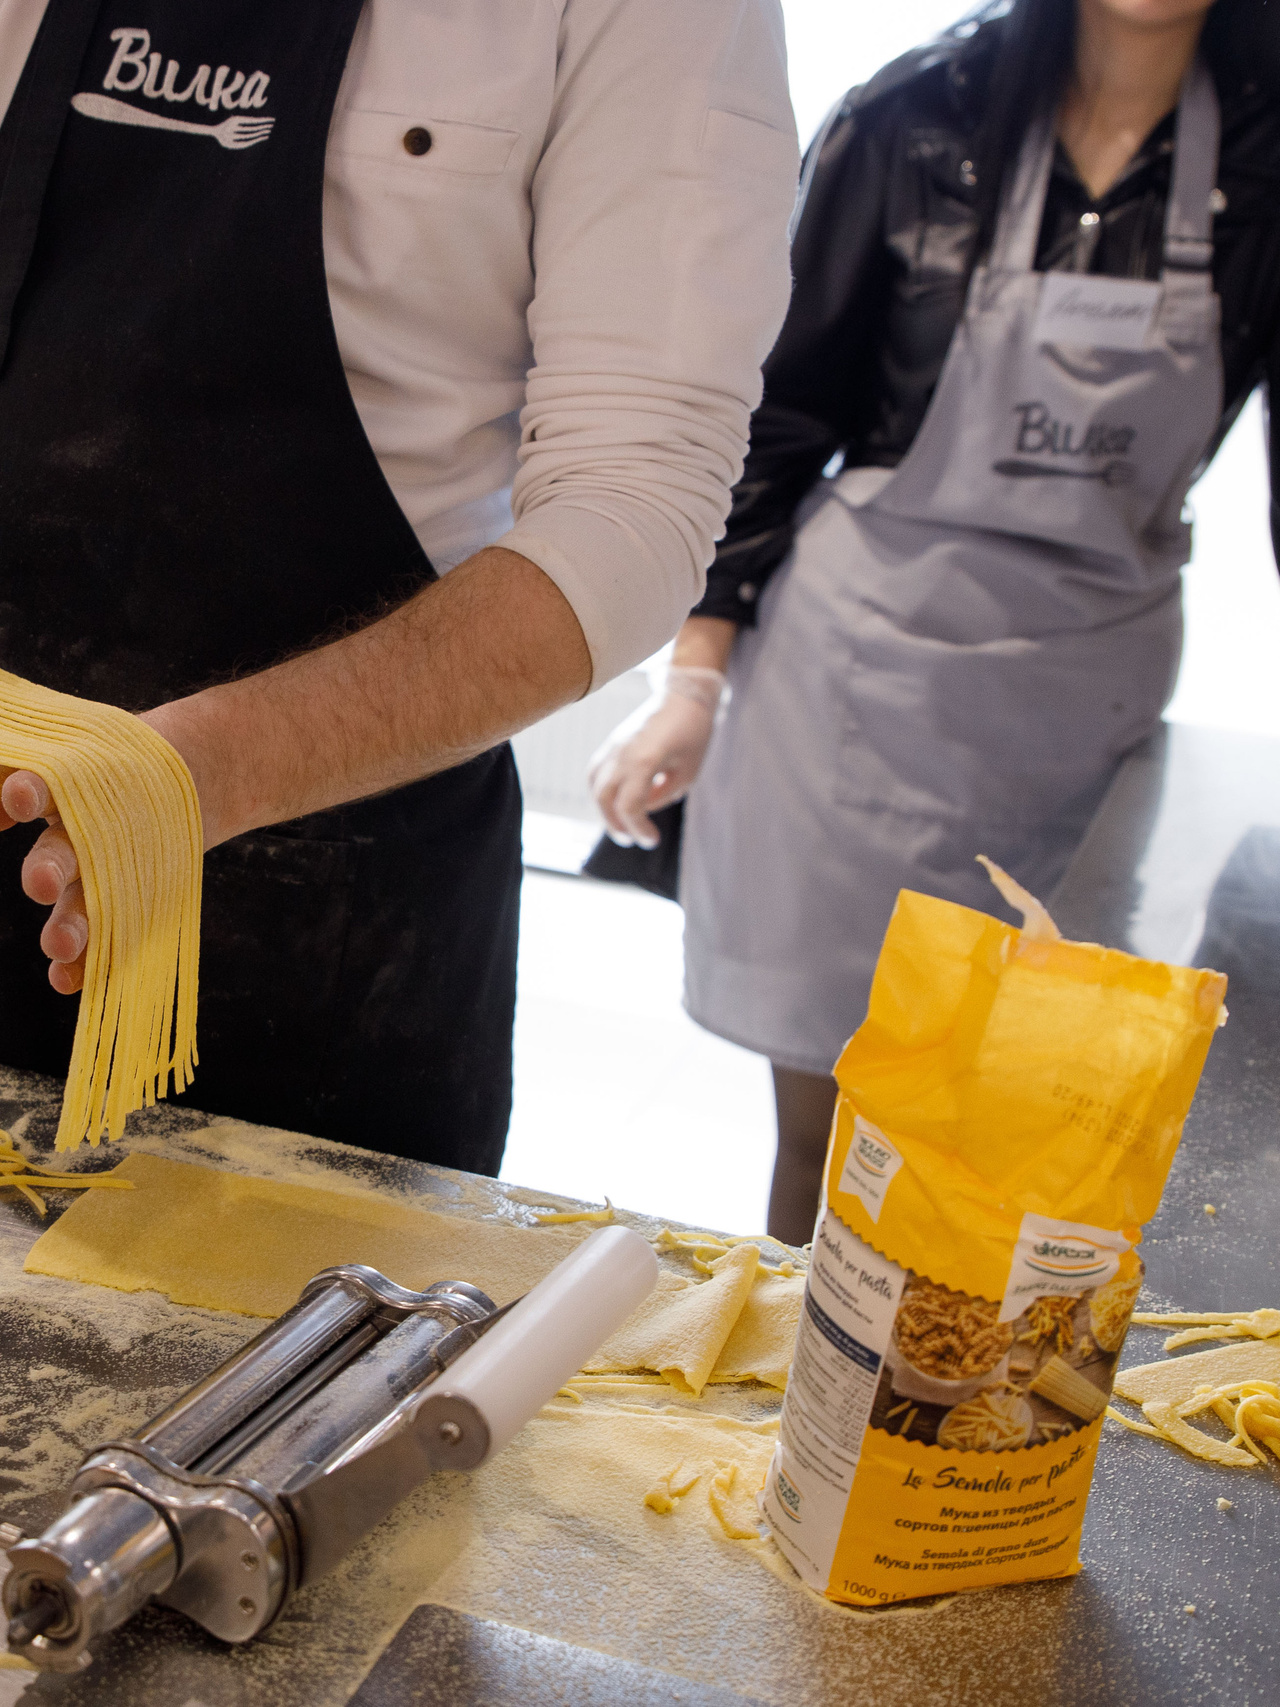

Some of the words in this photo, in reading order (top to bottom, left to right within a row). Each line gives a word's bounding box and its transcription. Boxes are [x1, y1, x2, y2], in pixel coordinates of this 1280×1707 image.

[103, 27, 271, 111] Вилка
[902, 1467, 924, 1490] La
[932, 1466, 1012, 1494] Semola
[1018, 1473, 1042, 1493] per
[940, 1506, 979, 1520] Мука
[982, 1509, 999, 1518] из
[1003, 1496, 1057, 1516] твердых
[895, 1518, 949, 1532] сортов
[1021, 1513, 1045, 1528] для
[922, 1549, 969, 1559] Semola
[972, 1546, 984, 1556] di
[986, 1543, 1021, 1556] grano
[1023, 1536, 1049, 1549] duro
[874, 1554, 911, 1569] Мука
[932, 1558, 984, 1571] твердых
[985, 1551, 1027, 1565] сортов
[844, 1580, 877, 1599] 1000
[879, 1591, 889, 1602] g
